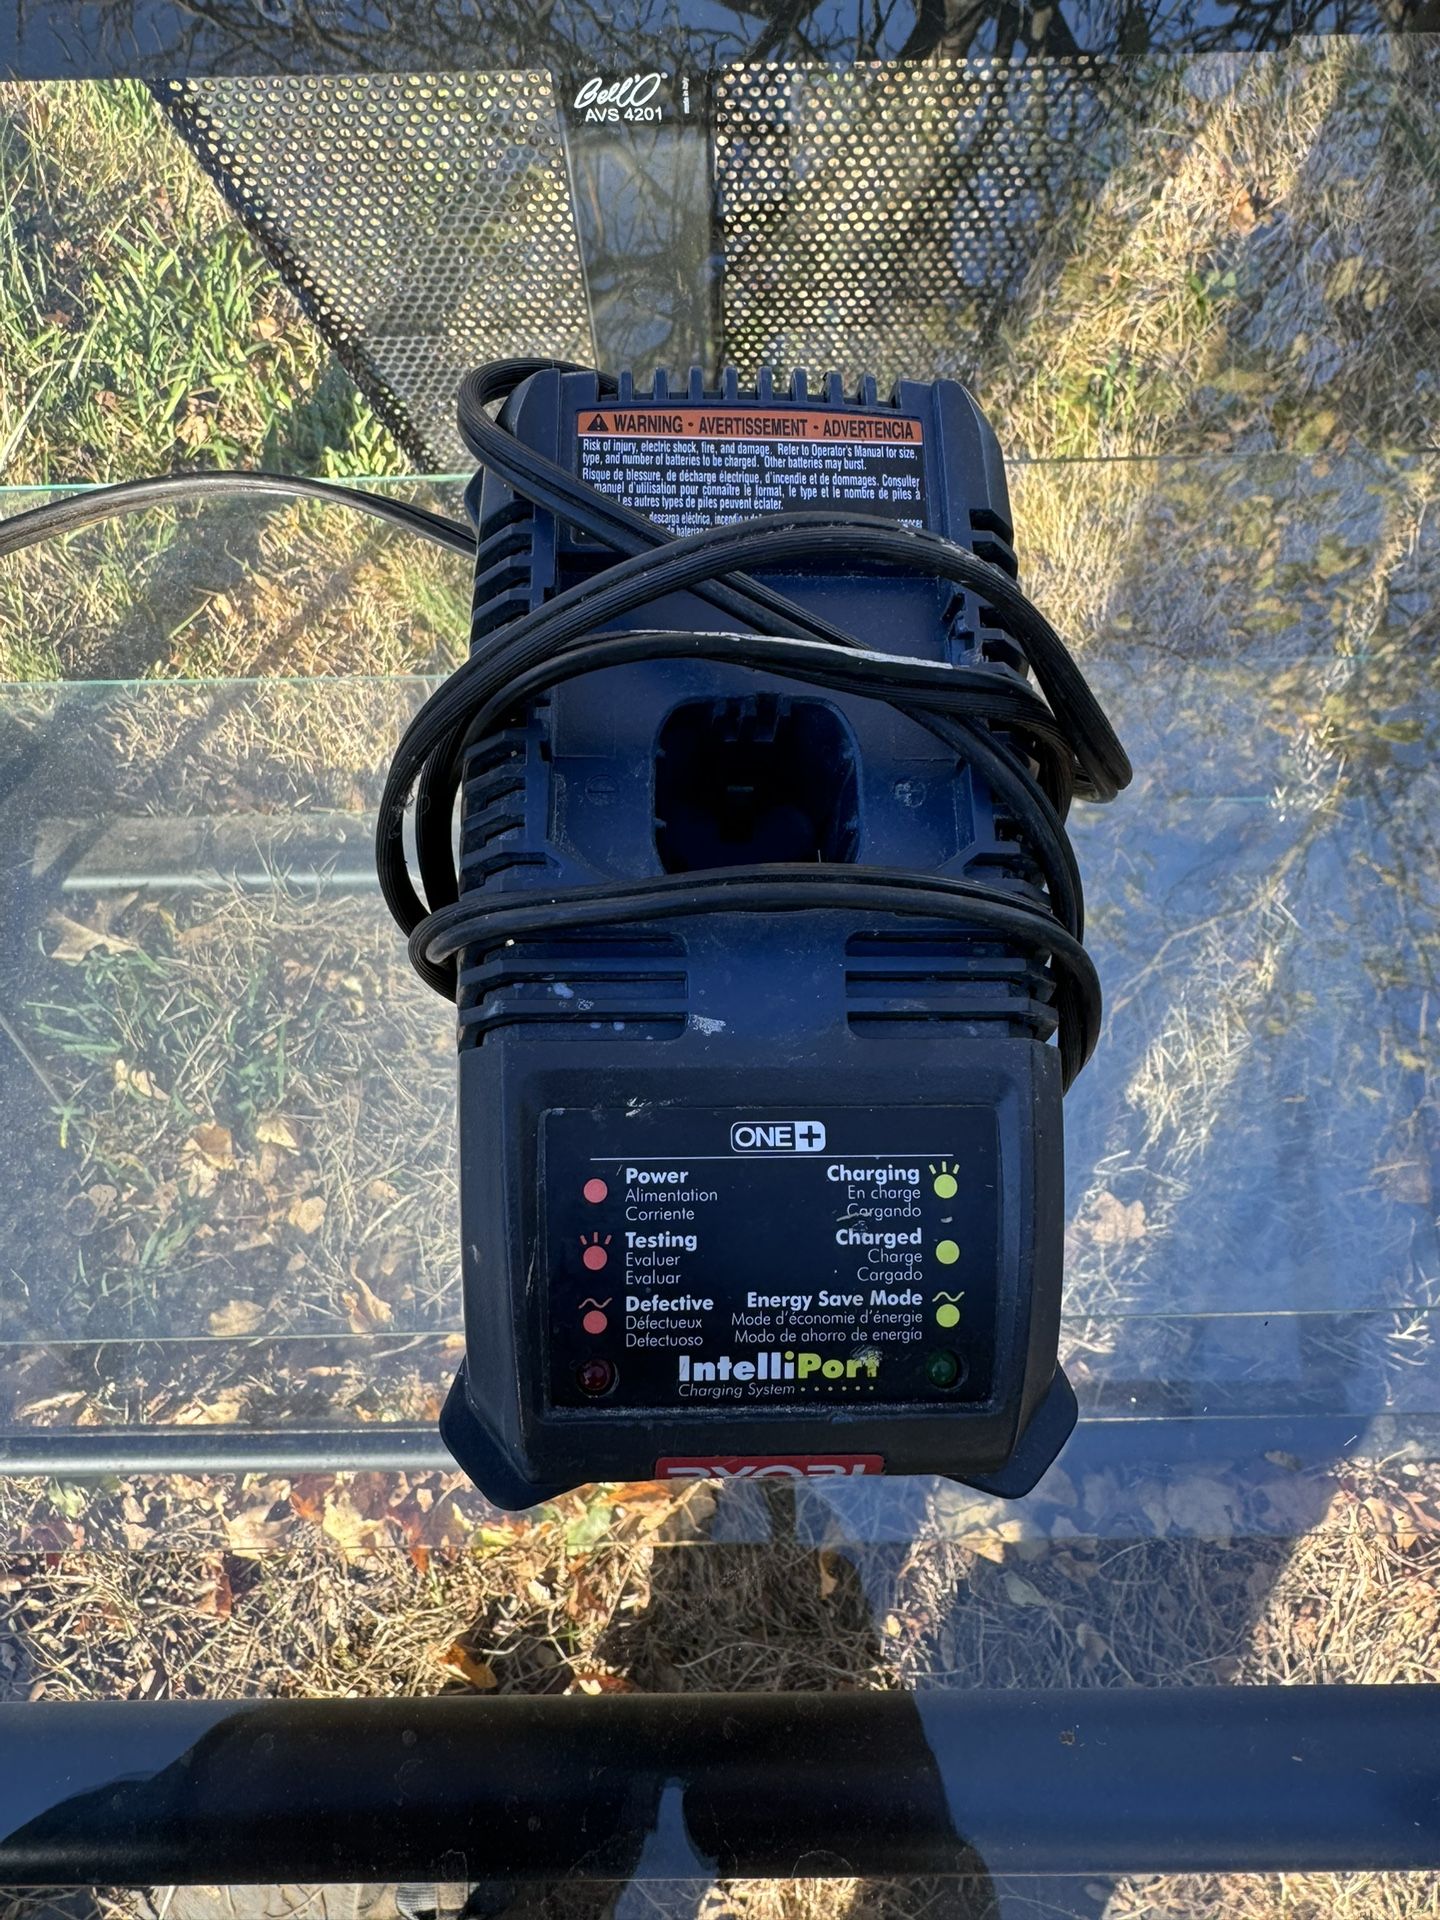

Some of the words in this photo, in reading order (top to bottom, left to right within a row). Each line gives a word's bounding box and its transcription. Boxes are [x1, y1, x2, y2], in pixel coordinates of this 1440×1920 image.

[585, 108, 620, 122] AVS
[624, 106, 662, 122] 4201
[614, 414, 683, 433] WARNING
[699, 416, 808, 437] AVERTISSEMENT
[823, 420, 914, 440] ADVERTENCIA
[583, 439, 600, 451] Risk
[603, 439, 611, 451] of
[613, 439, 638, 455] injury,
[641, 440, 671, 453] electric
[673, 441, 698, 455] shock,
[701, 441, 717, 455] fire,
[720, 442, 735, 454] and
[778, 443, 799, 456] Refer
[801, 444, 809, 456] to
[812, 444, 852, 459] Operator's
[854, 445, 884, 458] Manual
[886, 446, 897, 458] for
[899, 446, 918, 460] size,
[582, 453, 603, 466] type,
[605, 453, 620, 465] and
[622, 453, 653, 466] number
[655, 454, 663, 466] of
[665, 454, 700, 467] batteries
[702, 455, 711, 467] to
[712, 455, 722, 467] be
[724, 455, 760, 470] charged.
[764, 456, 786, 468] Other
[788, 456, 823, 469] batteries
[825, 460, 842, 472] may
[843, 458, 867, 470] burst.
[582, 468, 611, 483] Risque
[613, 468, 624, 481] de
[626, 469, 664, 482] blessure,
[666, 470, 677, 482] de
[679, 470, 716, 486] décharge
[719, 470, 763, 486] électrique,
[765, 471, 807, 485] d'incendie
[809, 473, 818, 485] et
[820, 473, 830, 486] de
[832, 473, 880, 489] dommages.
[882, 474, 920, 488] Consulter
[594, 481, 624, 493] manuel
[628, 481, 677, 495] d'utilisation
[680, 485, 698, 498] pour
[702, 483, 740, 497] connaître
[744, 484, 752, 496] le
[755, 484, 785, 499] format,
[789, 485, 797, 498] le
[800, 485, 817, 500] type
[821, 486, 829, 498] et
[832, 486, 841, 498] le
[844, 488, 875, 500] nombre
[878, 487, 889, 500] de
[892, 488, 912, 502] piles
[634, 495, 660, 508] autres
[662, 495, 684, 510] types
[686, 496, 695, 508] de
[698, 496, 717, 511] piles
[720, 497, 752, 511] peuvent
[754, 497, 784, 510] éclater.
[649, 511, 680, 527] descarga
[625, 1168, 688, 1184] Power
[827, 1164, 920, 1185] Charging
[625, 1187, 718, 1203] Alimentation
[848, 1185, 865, 1199] En
[871, 1184, 921, 1202] charge
[625, 1207, 695, 1222] Corriente
[847, 1203, 922, 1221] Cargando
[625, 1231, 697, 1251] Testing
[835, 1227, 922, 1249] Charged
[626, 1252, 680, 1267] Evaluer
[868, 1248, 923, 1266] Charge
[626, 1271, 681, 1285] Evaluar
[857, 1266, 923, 1285] Cargado
[625, 1295, 714, 1312] Defective
[747, 1292, 813, 1311] Energy
[818, 1291, 864, 1307] Save
[870, 1290, 923, 1306] Mode
[626, 1316, 702, 1330] Défectueux
[732, 1311, 771, 1326] Mode
[777, 1311, 855, 1326] d'économie
[860, 1310, 923, 1327] d'énergie
[626, 1333, 703, 1348] Defectuoso
[735, 1329, 775, 1344] Modo
[779, 1328, 797, 1343] de
[801, 1328, 846, 1343] ahorro
[851, 1327, 868, 1342] de
[872, 1328, 923, 1344] energía
[679, 1384, 742, 1399] Charging
[748, 1382, 795, 1398] System
